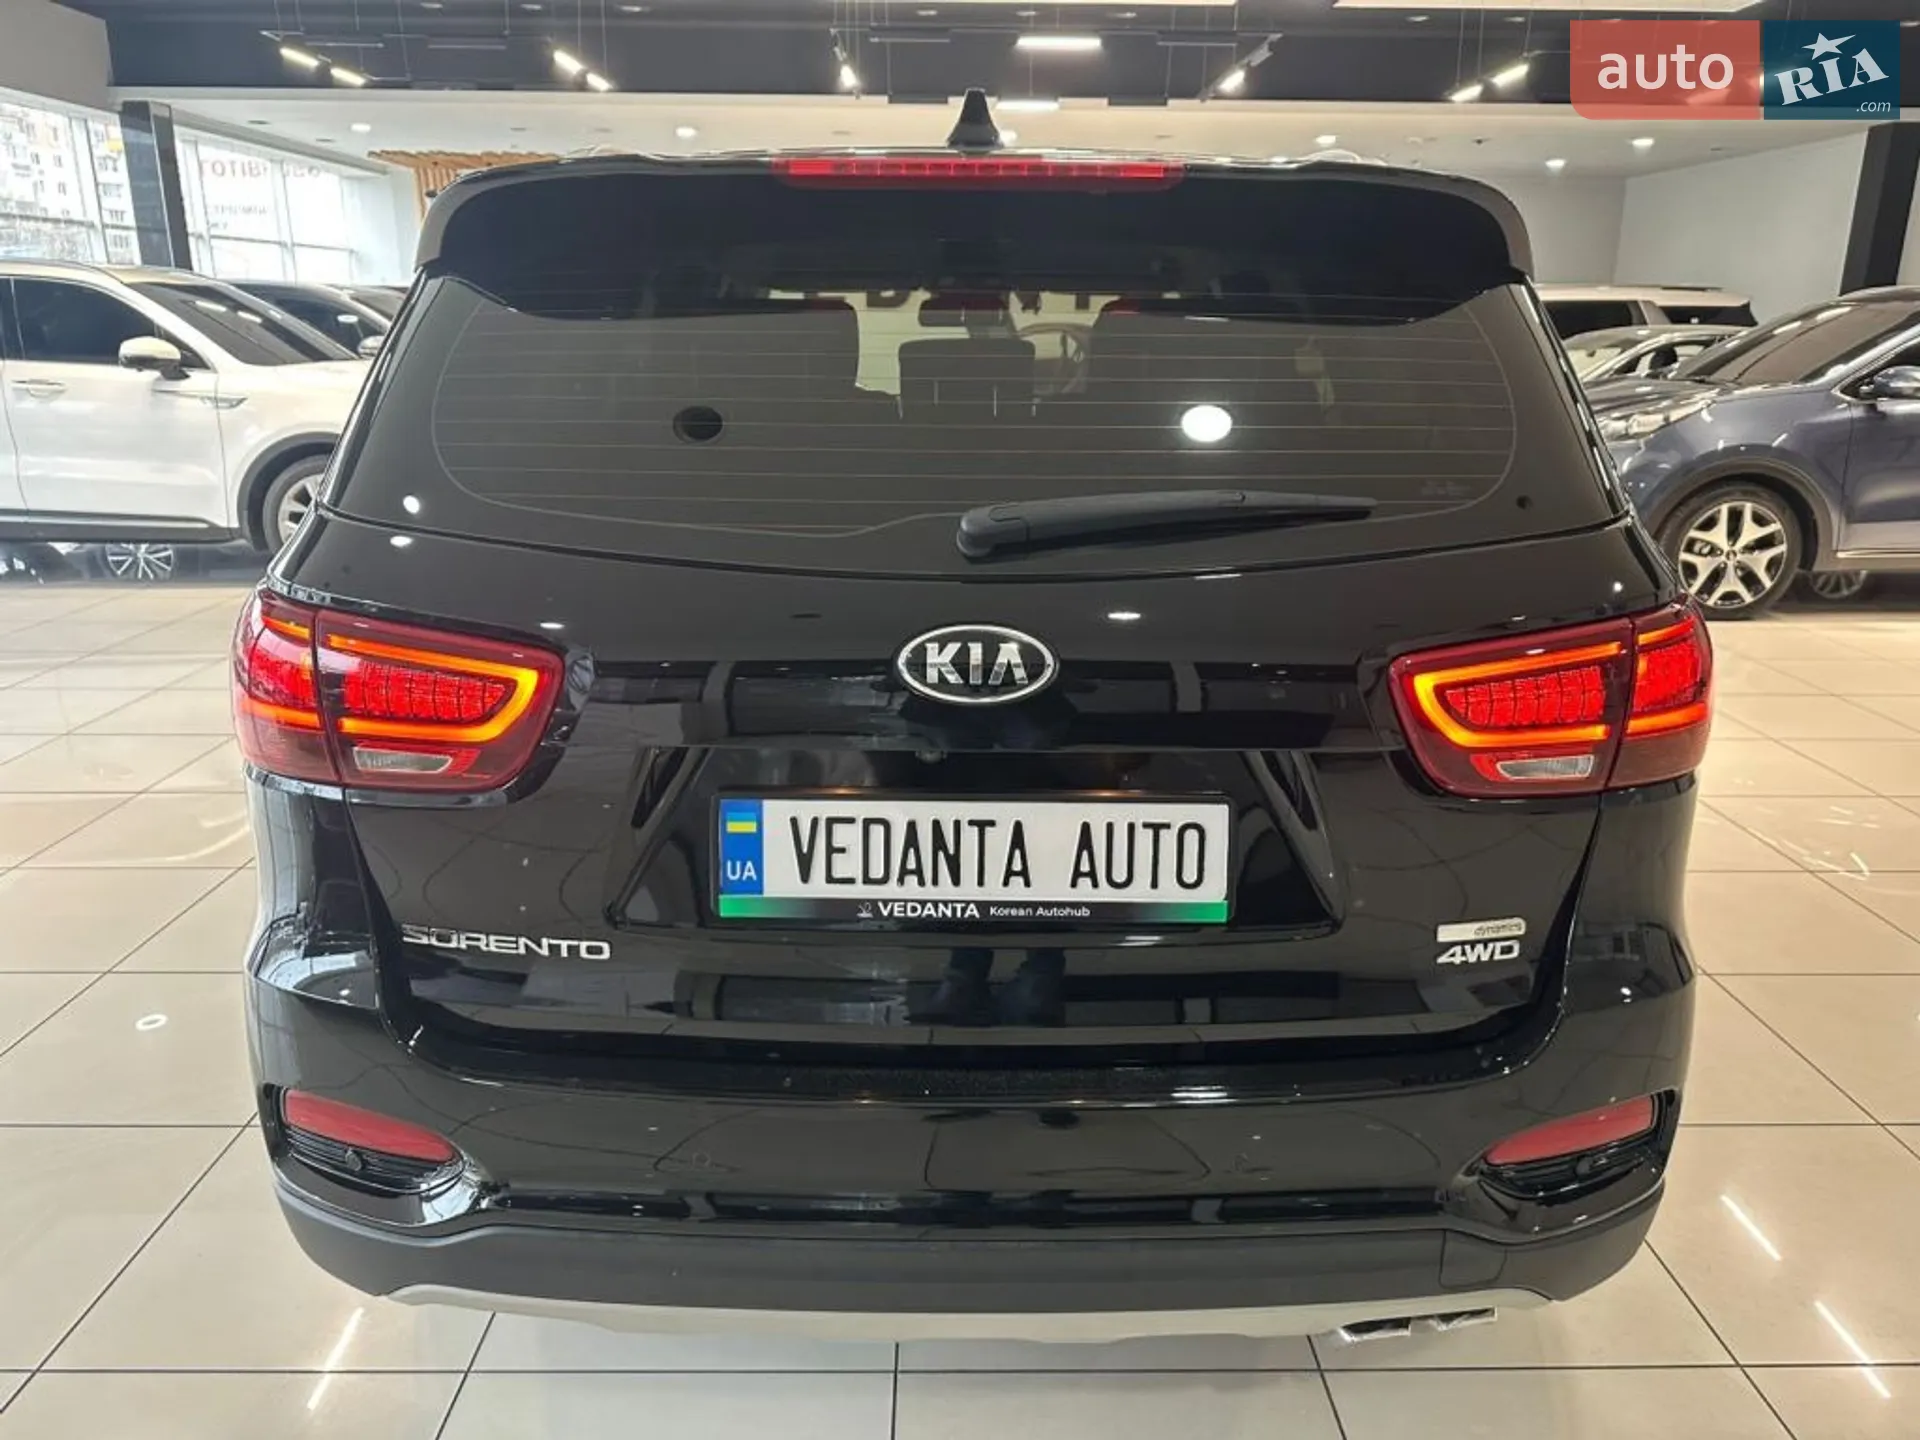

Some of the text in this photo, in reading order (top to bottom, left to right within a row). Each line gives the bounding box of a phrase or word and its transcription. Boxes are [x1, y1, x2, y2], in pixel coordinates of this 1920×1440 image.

[925, 641, 1029, 685] KIA
[789, 816, 1207, 890] VEDANTA AUTO
[726, 860, 757, 881] UA
[877, 901, 1091, 919] VEDANTA Korean Autohub
[402, 923, 611, 960] SORENTO
[1436, 939, 1520, 964] 4WD
